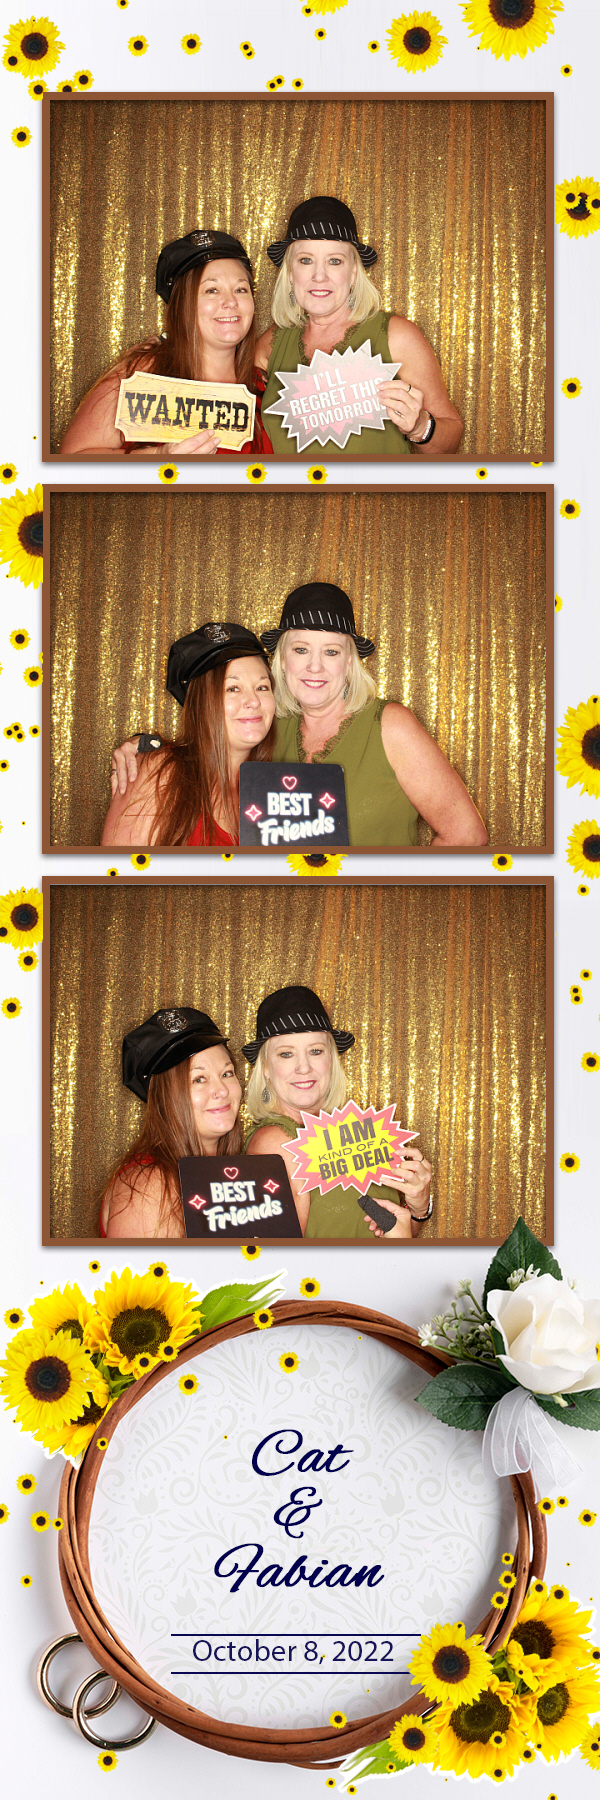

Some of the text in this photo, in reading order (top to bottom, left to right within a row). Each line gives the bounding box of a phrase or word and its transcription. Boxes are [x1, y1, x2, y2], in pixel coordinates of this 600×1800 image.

[313, 368, 347, 391] I'LL
[125, 392, 249, 432] WANTED
[289, 387, 346, 416] REGRET
[267, 792, 312, 816] BEST
[257, 808, 335, 846] Friends
[318, 1137, 389, 1162] KIND OF A
[322, 1117, 376, 1151] I AM
[318, 1145, 395, 1181] BIG DEAL
[209, 1180, 256, 1203] BEST
[202, 1194, 283, 1232] Friends
